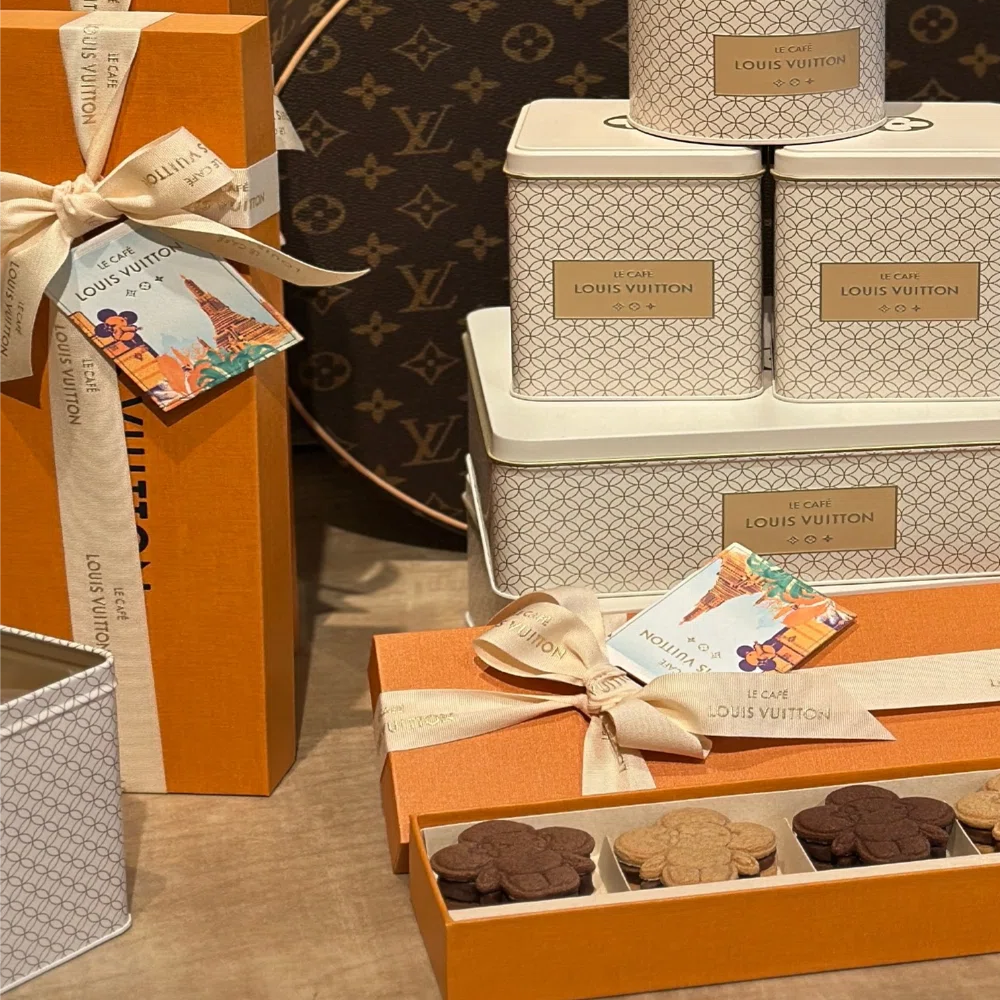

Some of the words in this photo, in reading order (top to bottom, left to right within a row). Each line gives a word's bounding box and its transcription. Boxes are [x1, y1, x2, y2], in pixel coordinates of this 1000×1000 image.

[81, 23, 99, 60] OUIS
[774, 46, 785, 54] LE
[787, 43, 813, 53] CAFÉ
[734, 60, 782, 71] LOUIS
[785, 54, 846, 70] VUITTON
[80, 65, 98, 126] VUITTON
[97, 259, 110, 270] LE
[109, 246, 137, 264] CAFÉ
[5, 260, 20, 304] LOUIS
[75, 273, 121, 302] LOUIS
[118, 241, 184, 277] VUITTON
[574, 283, 621, 294] LOUIS
[625, 283, 693, 294] VUITTON
[841, 286, 887, 296] LOUIS
[892, 285, 959, 296] VUITTON
[0, 302, 14, 358] VUITTON
[55, 325, 72, 366] LOUIS
[61, 368, 82, 425] VUITTON
[789, 501, 800, 509] LE
[803, 498, 832, 509] CAFÉ
[745, 516, 796, 529] LOUIS
[801, 512, 875, 526] VUITTON
[86, 554, 101, 594] LOUIS
[113, 586, 124, 598] LE
[639, 628, 696, 667] VUITTON
[747, 689, 758, 699] LE
[761, 688, 789, 700] CAFÉ
[707, 705, 755, 719] LOUIS
[759, 706, 831, 720] VUITTON
